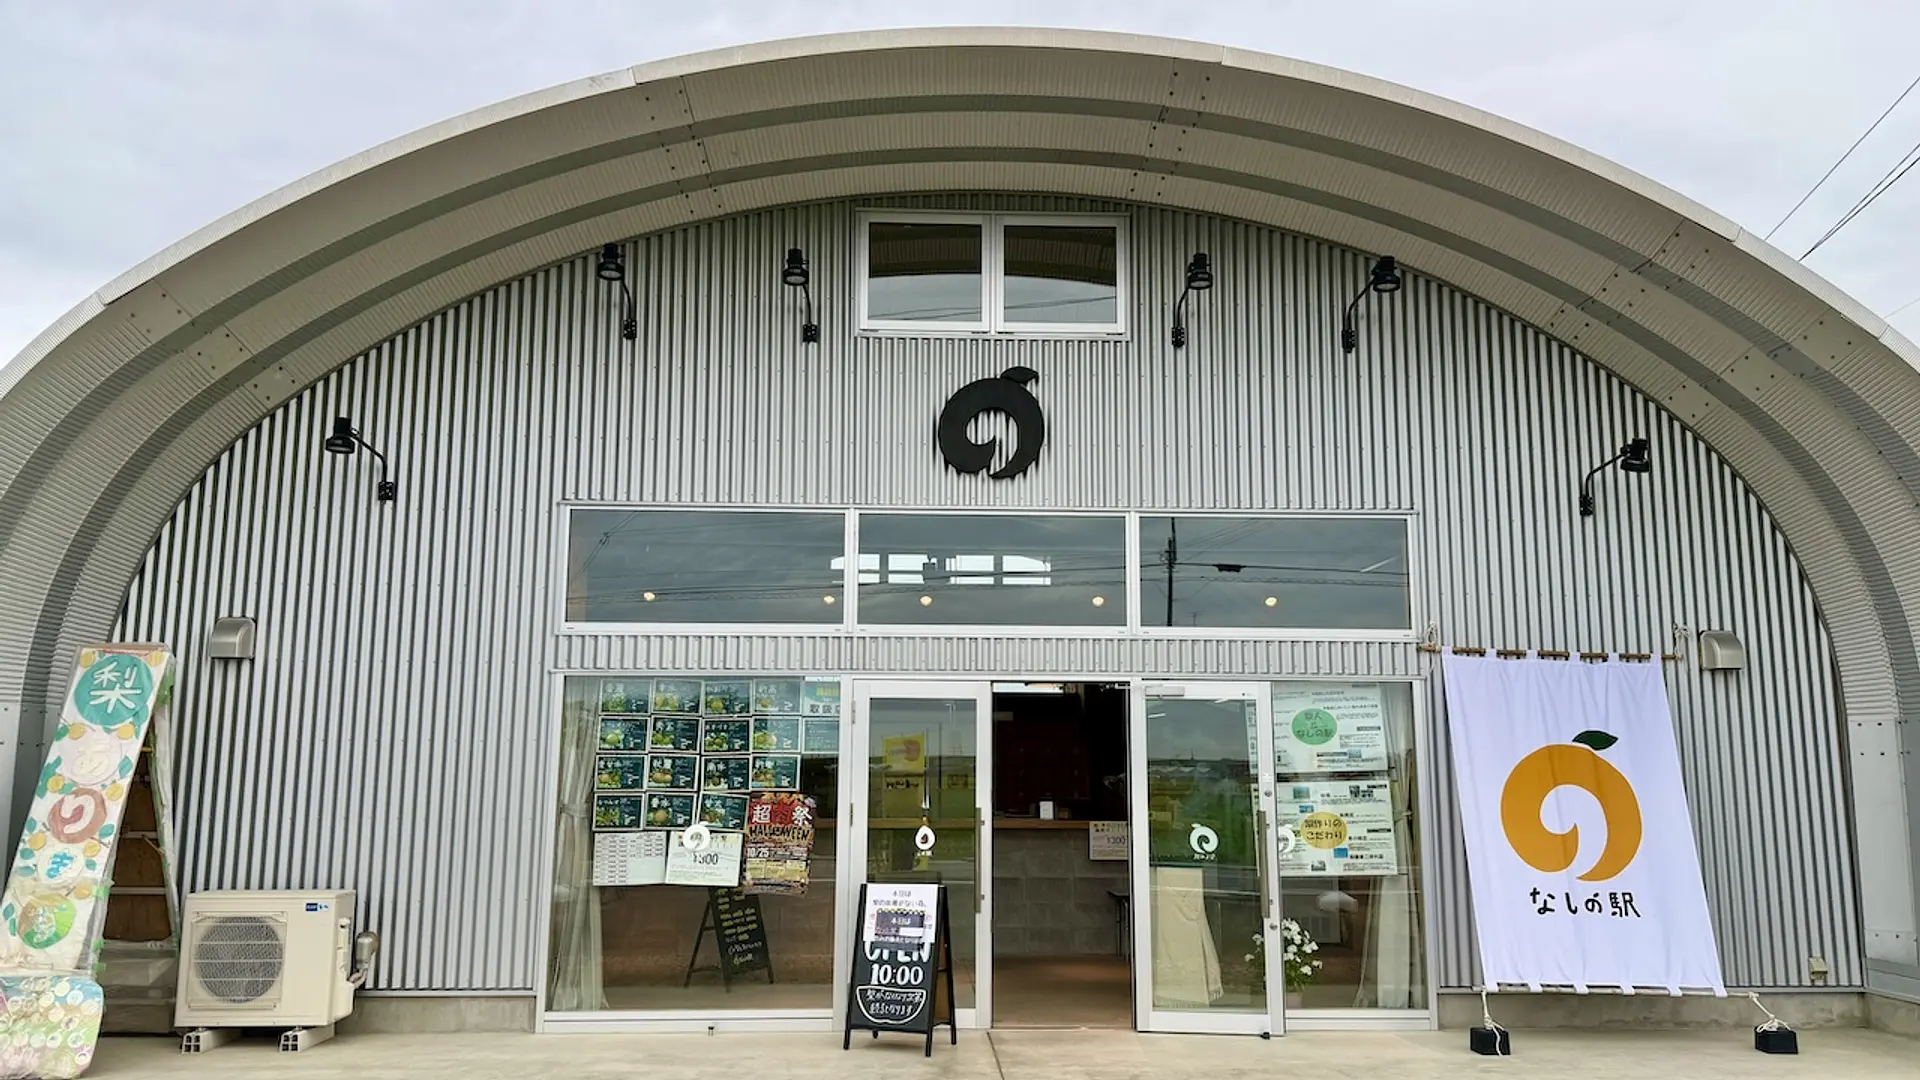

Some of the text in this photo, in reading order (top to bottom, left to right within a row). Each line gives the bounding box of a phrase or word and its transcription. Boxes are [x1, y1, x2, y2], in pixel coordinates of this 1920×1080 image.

[749, 824, 811, 841] HALLOWEEN
[1530, 887, 1642, 918] なしの駅
[870, 963, 924, 985] 10:00
